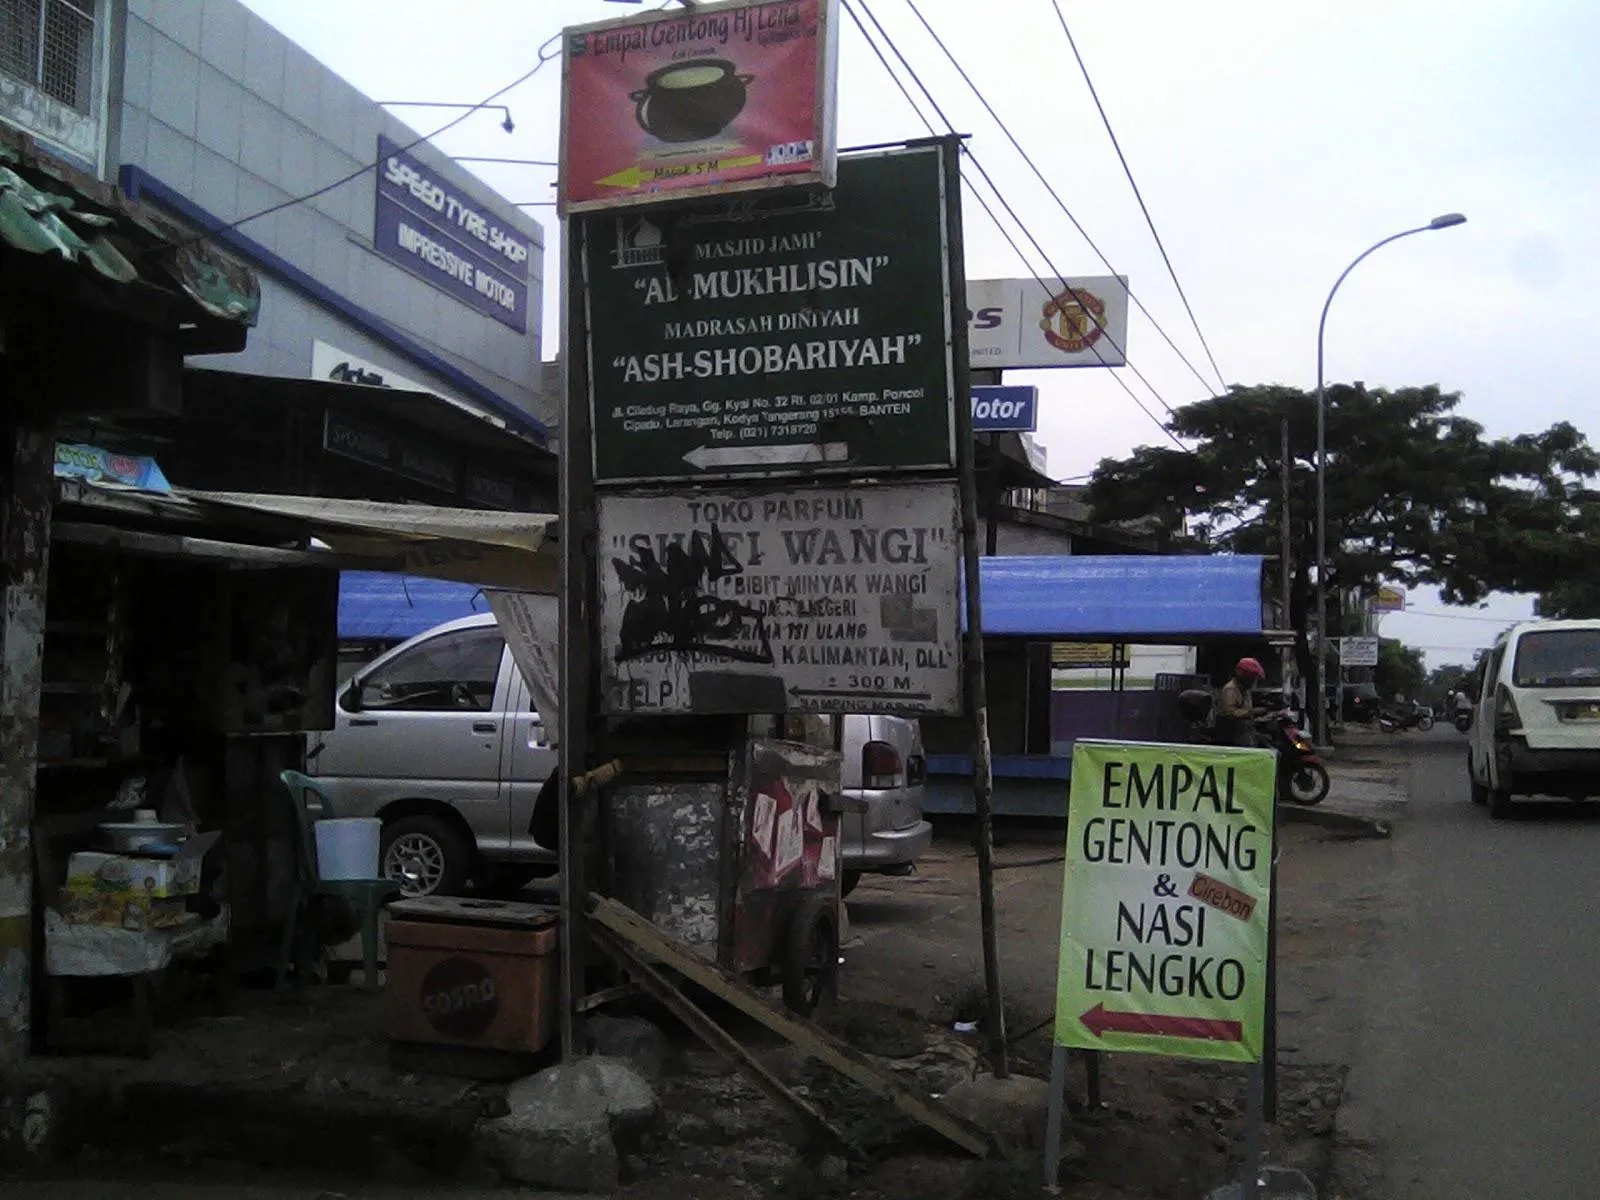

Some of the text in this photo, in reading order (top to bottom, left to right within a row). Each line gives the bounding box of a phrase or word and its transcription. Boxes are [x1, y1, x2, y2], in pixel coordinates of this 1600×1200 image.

[594, 25, 647, 64] Empal
[651, 15, 729, 46] Gentong
[384, 156, 527, 264] SPEED TYRE SHOP
[694, 238, 765, 259] MASJID
[397, 222, 515, 312] IMPRESSIVE MOTOR
[664, 307, 860, 340] MADRASAH DINIYAH
[842, 391, 878, 404] Kamp.
[859, 404, 911, 417] BANTEN
[688, 498, 864, 524] TOKO PARFUM
[786, 574, 857, 594] MINYAK
[866, 574, 927, 594] WANGI
[816, 623, 867, 641] ULANG
[783, 647, 909, 670] KALIMANTAN,
[848, 676, 885, 690] 300
[893, 677, 910, 690] M
[1102, 762, 1244, 815] EMPAL
[1083, 817, 1257, 871] GENTONG
[1153, 874, 1179, 898] &
[1190, 876, 1252, 918] Cirebon
[1117, 901, 1205, 948] NASI
[1085, 948, 1245, 1001] LENGKO
